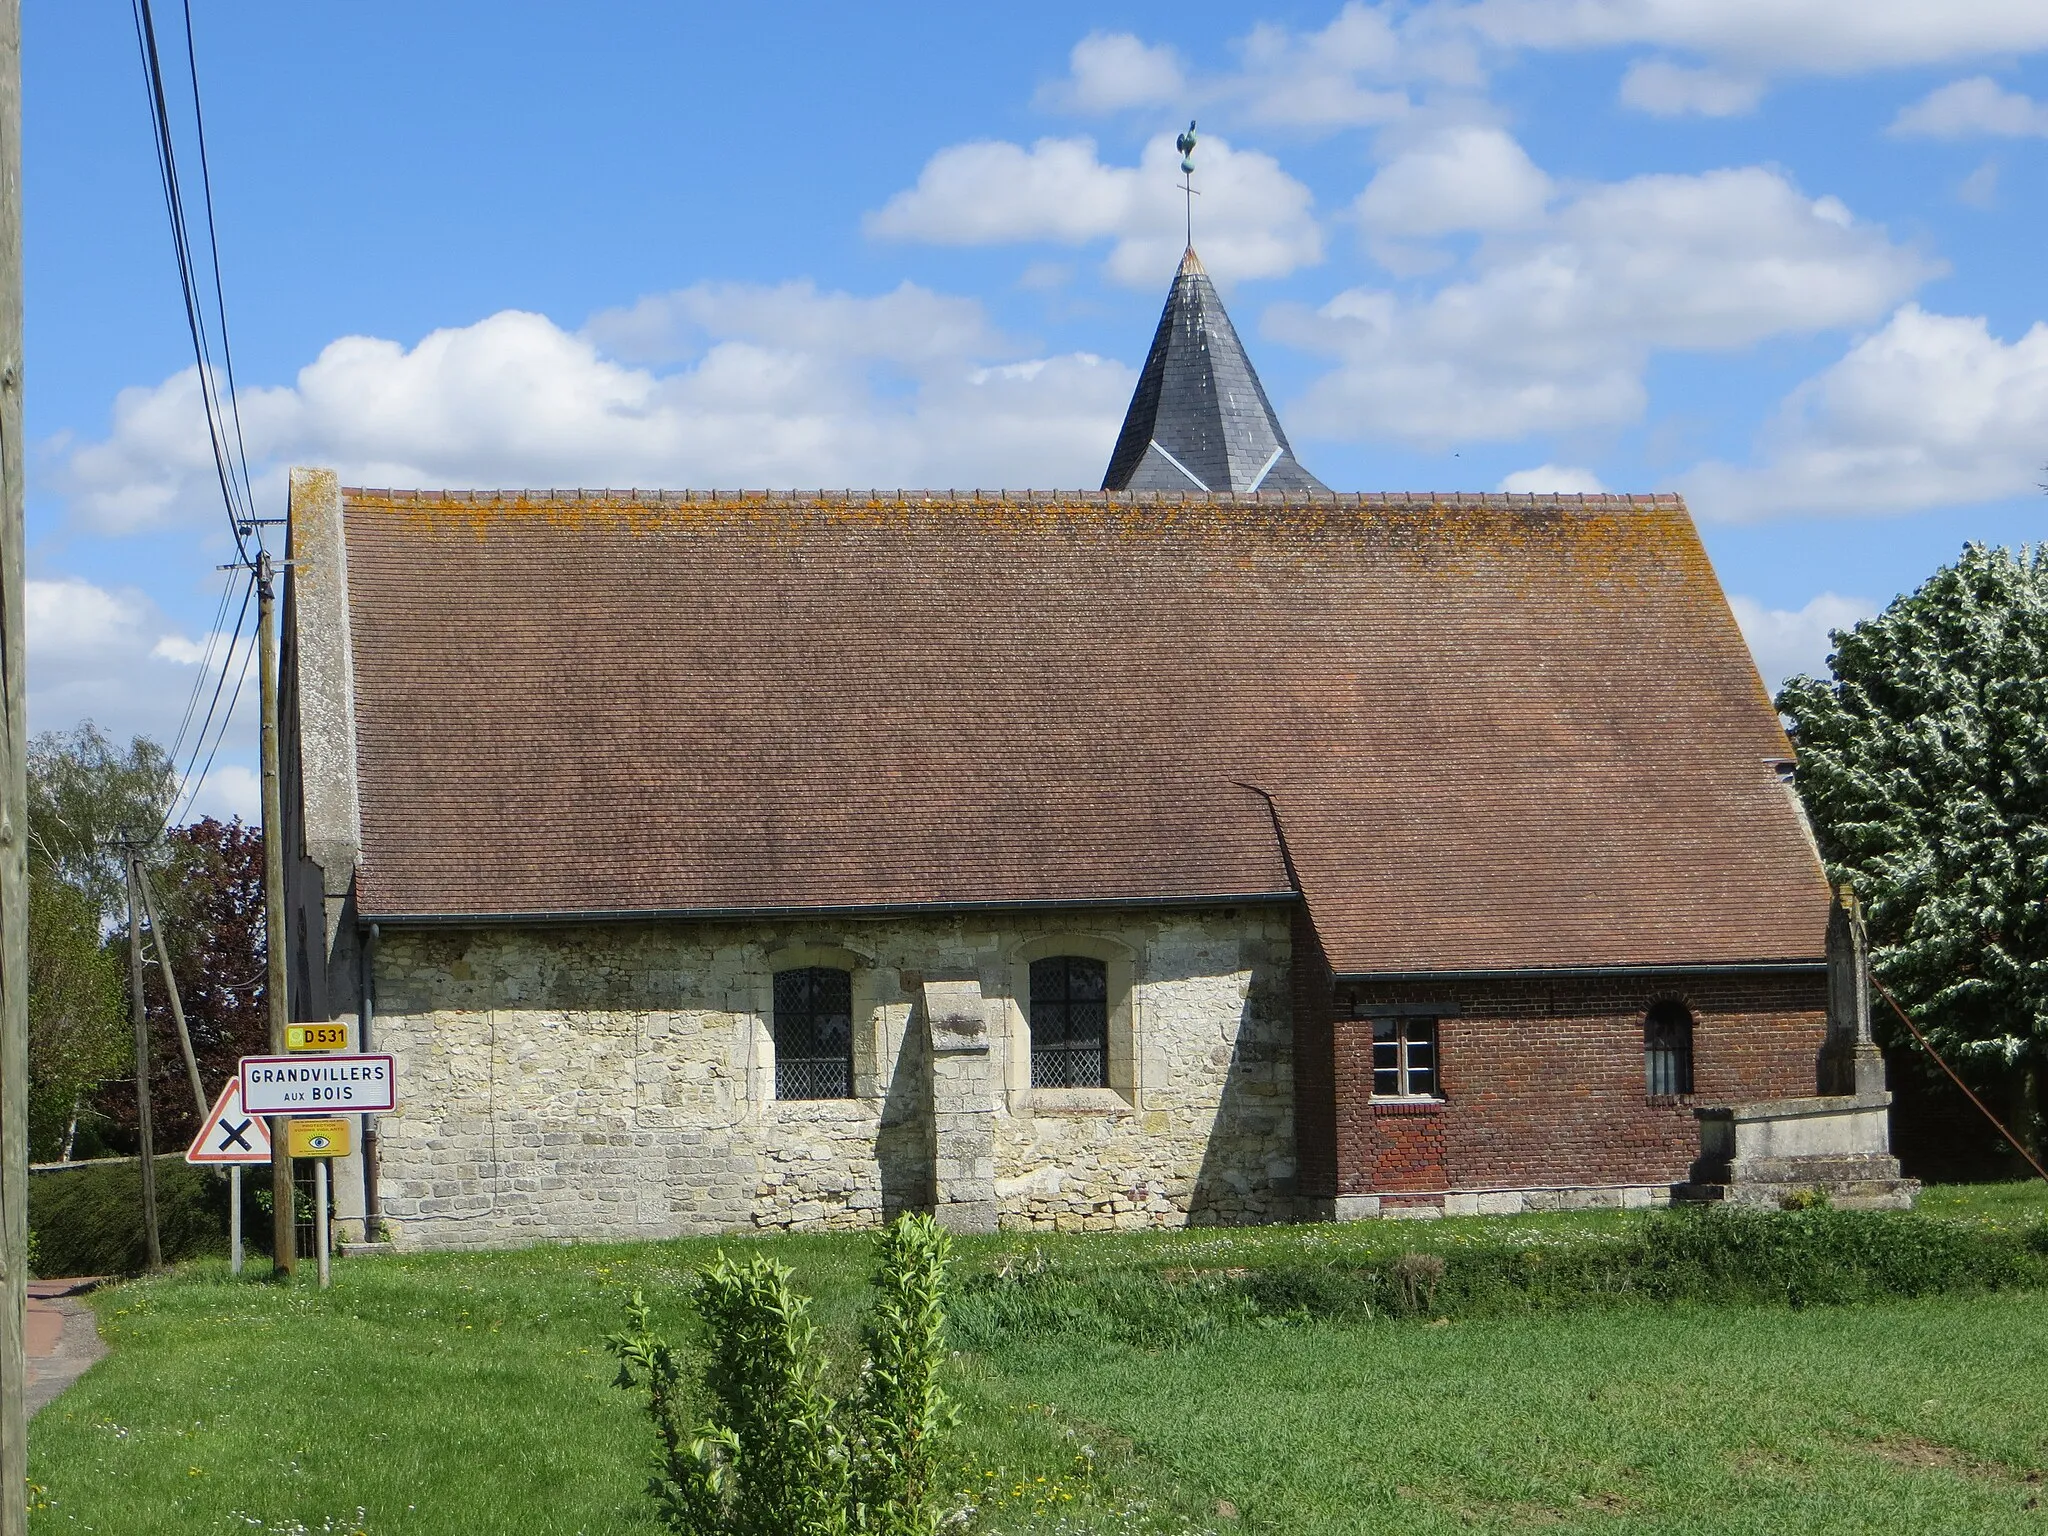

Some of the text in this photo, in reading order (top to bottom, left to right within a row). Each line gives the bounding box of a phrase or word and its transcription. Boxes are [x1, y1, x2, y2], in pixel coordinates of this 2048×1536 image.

[305, 1029, 345, 1043] D 531
[251, 1066, 384, 1083] GRANDVILLERS
[284, 1086, 353, 1101] AUX BOIS
